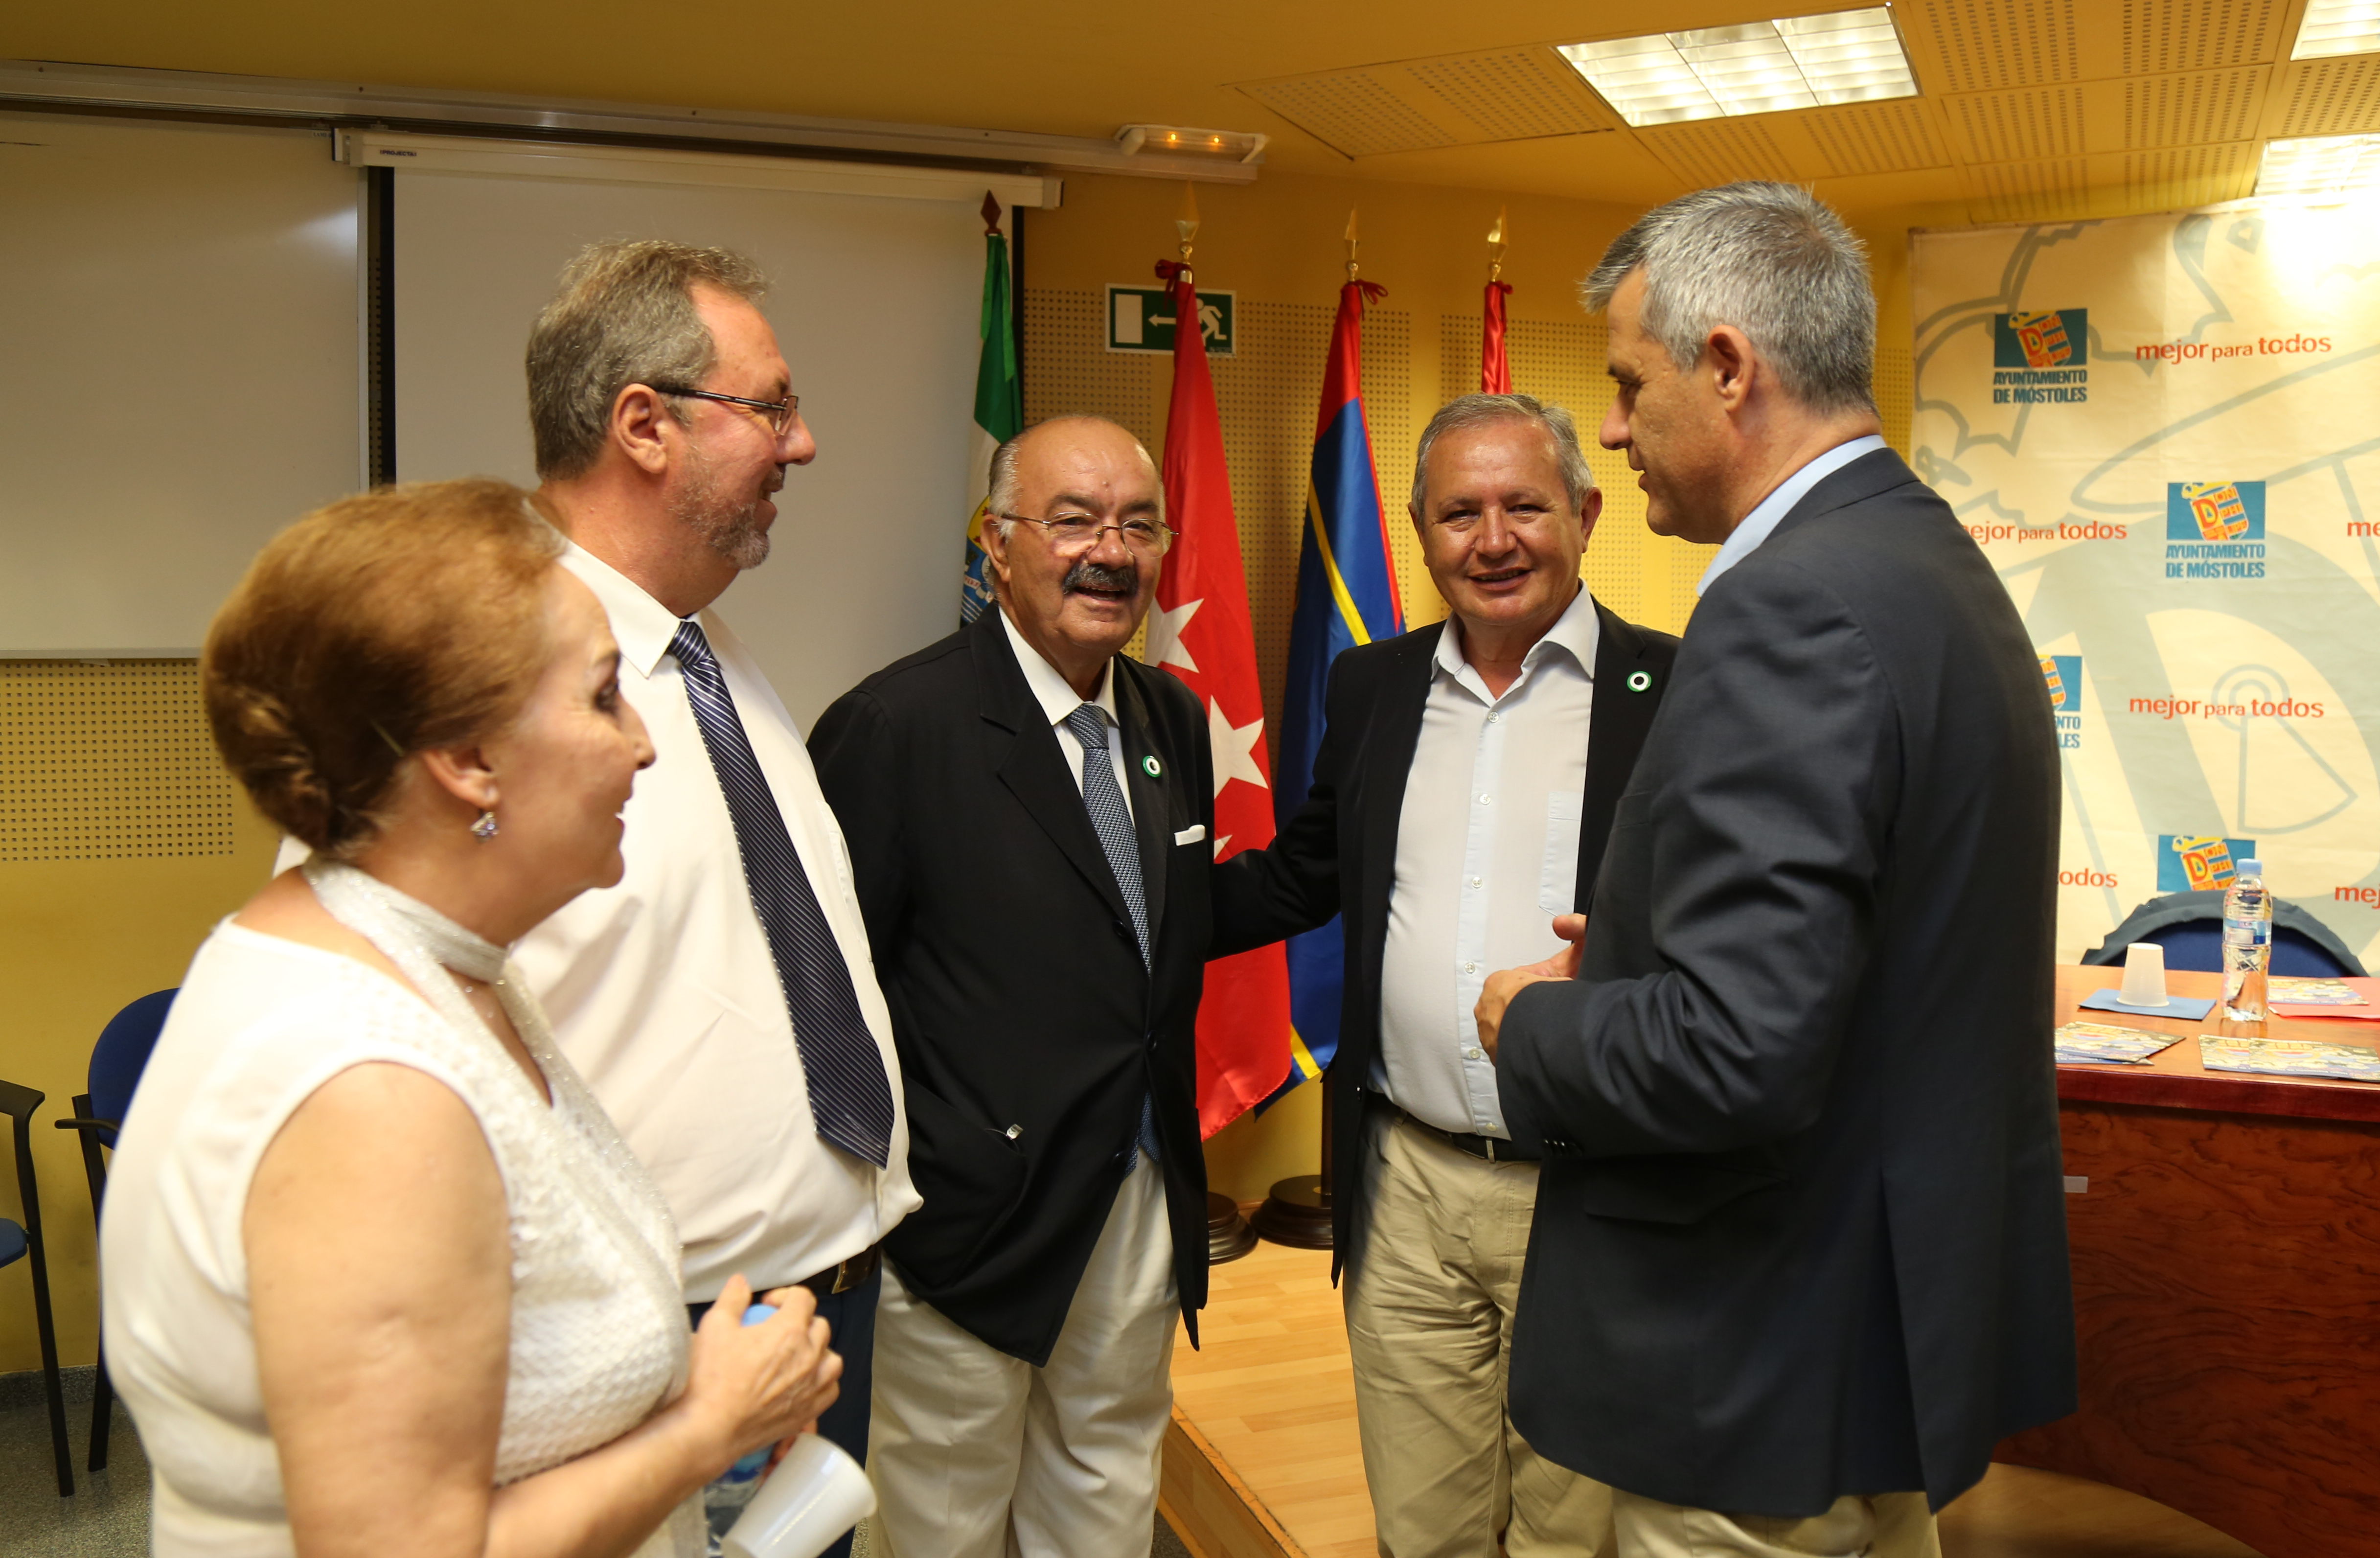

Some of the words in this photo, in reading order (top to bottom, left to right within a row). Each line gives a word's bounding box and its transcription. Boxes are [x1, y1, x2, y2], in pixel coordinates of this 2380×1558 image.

[2136, 340, 2209, 365] mejor
[2212, 345, 2252, 362] para
[2258, 334, 2332, 355] todos
[1993, 369, 2087, 385] AYUNTAMIENTO
[1993, 389, 2011, 404] DE
[2014, 386, 2087, 404] MÓSTOLES
[2018, 529, 2054, 543] para
[2059, 521, 2127, 540] todos
[2166, 544, 2265, 558] AYUNTAMIENTO
[2166, 563, 2183, 577] DE
[2187, 560, 2265, 577] MÓSTOLES
[2129, 695, 2201, 719] mejor
[2204, 704, 2245, 718] para
[2251, 698, 2324, 717] todos
[2059, 868, 2118, 888] odos
